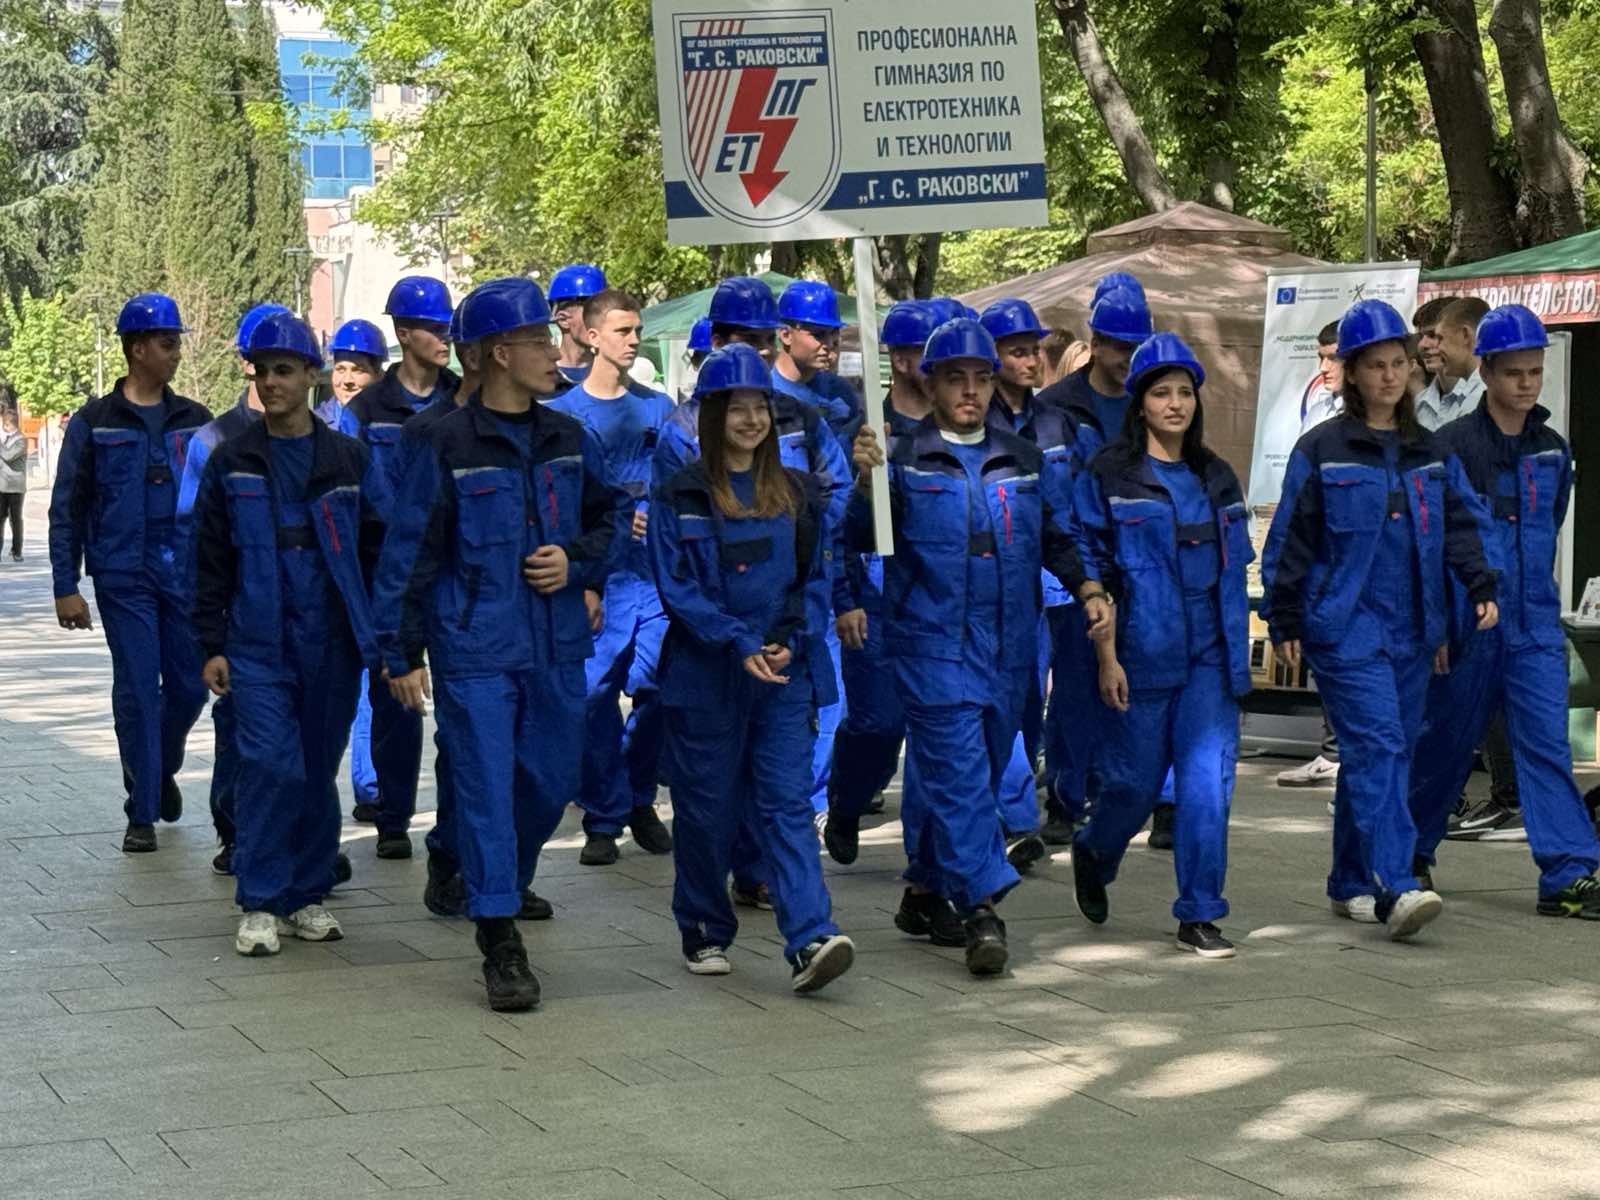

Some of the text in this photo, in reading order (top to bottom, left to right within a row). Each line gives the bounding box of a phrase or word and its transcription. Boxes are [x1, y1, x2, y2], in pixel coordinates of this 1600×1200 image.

[857, 25, 1018, 53] ПРОФЕСИОНАЛНА
[715, 50, 732, 67] С.
[874, 60, 1005, 87] ГИМНАЗИЯ ПО
[764, 78, 818, 117] ПГ
[863, 95, 1021, 122] ЕЛЕКТРОТЕХНИКА
[715, 134, 761, 173] ЕТ
[876, 131, 1012, 158] И ТЕХНОЛОГИИ
[892, 178, 911, 199] С.
